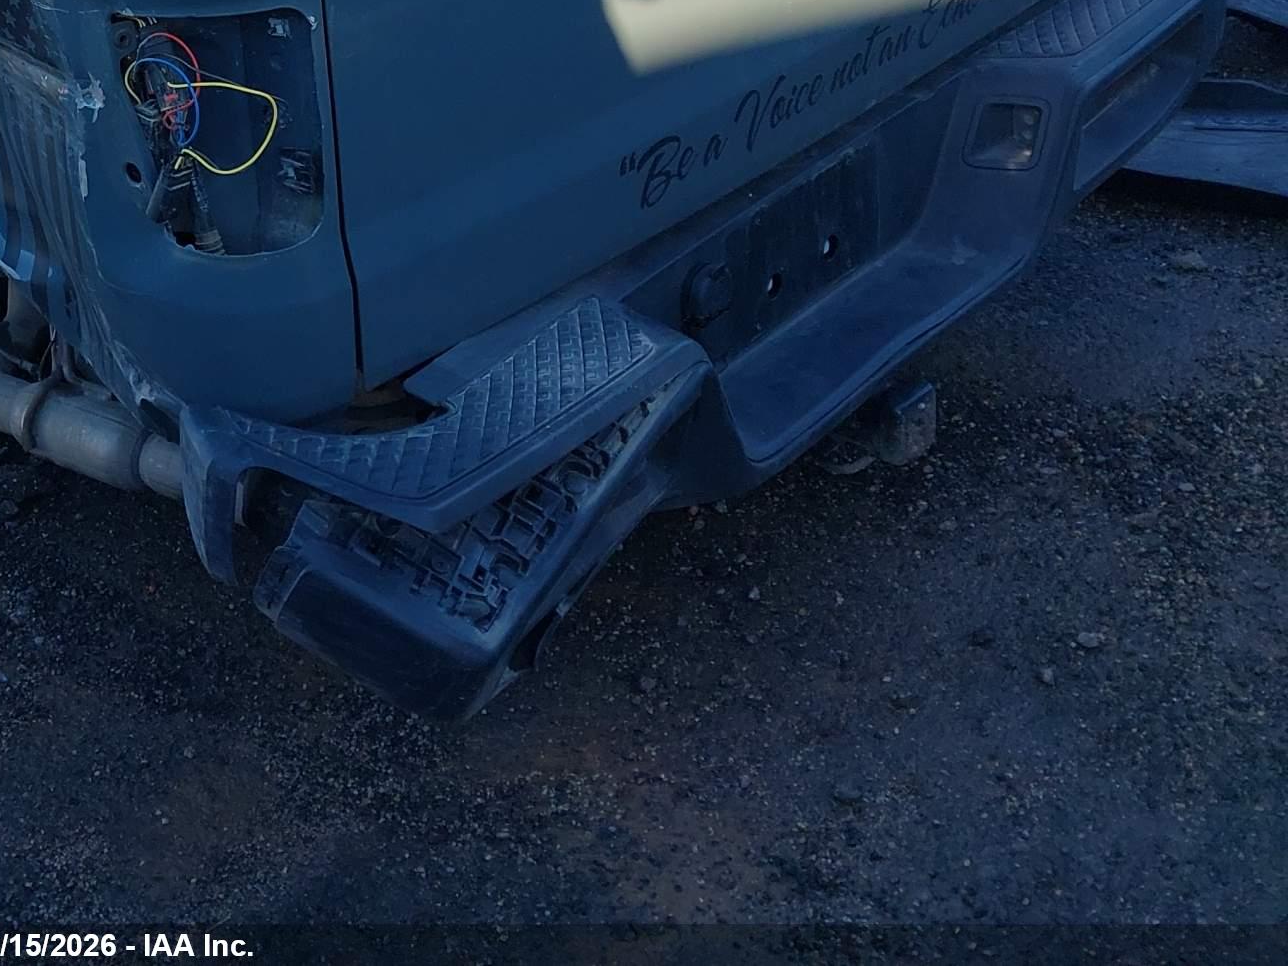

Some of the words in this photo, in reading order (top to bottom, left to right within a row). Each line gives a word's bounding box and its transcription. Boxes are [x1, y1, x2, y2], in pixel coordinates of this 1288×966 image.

[703, 134, 729, 167] a
[734, 75, 823, 152] Voice
[830, 25, 890, 94] not
[878, 25, 916, 67] an
